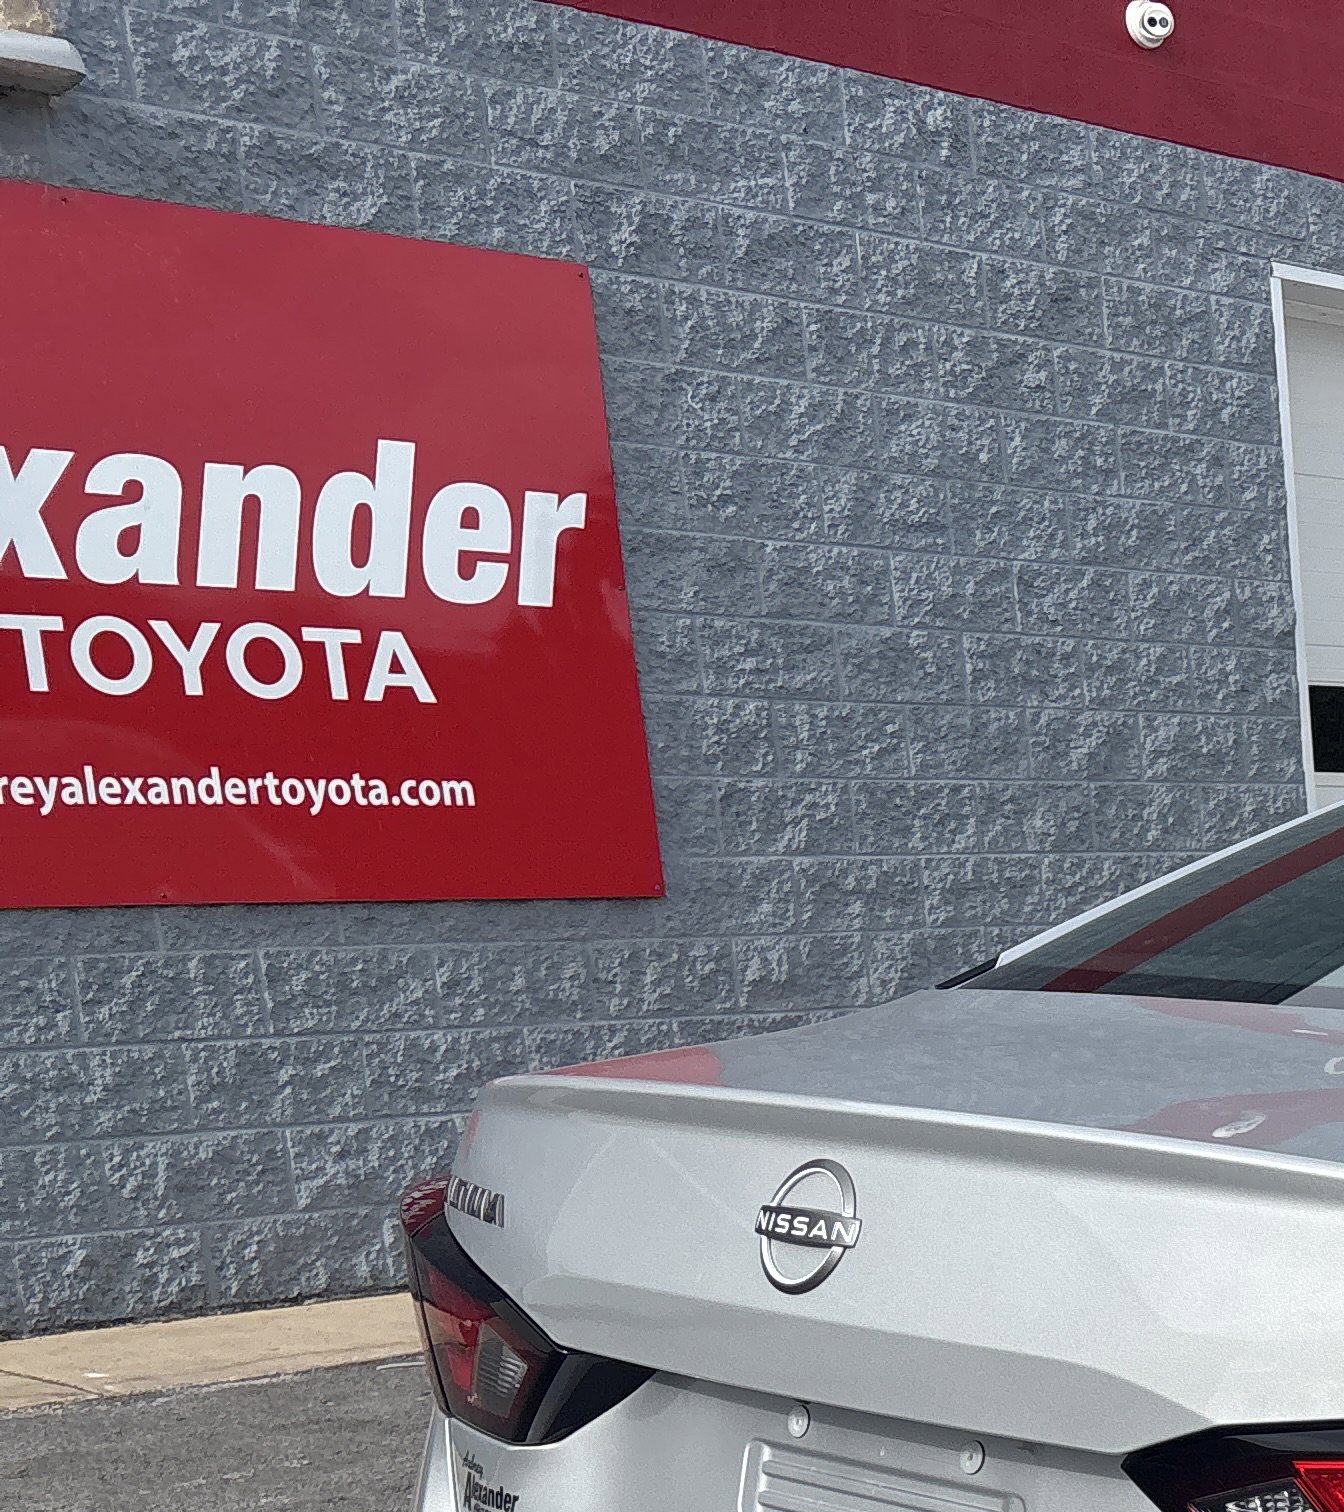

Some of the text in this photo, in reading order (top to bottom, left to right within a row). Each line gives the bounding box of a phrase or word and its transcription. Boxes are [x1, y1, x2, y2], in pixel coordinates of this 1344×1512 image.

[0, 613, 438, 704] TOYOTA
[756, 1210, 858, 1243] NISSAN
[464, 1471, 519, 1512] Alexander
